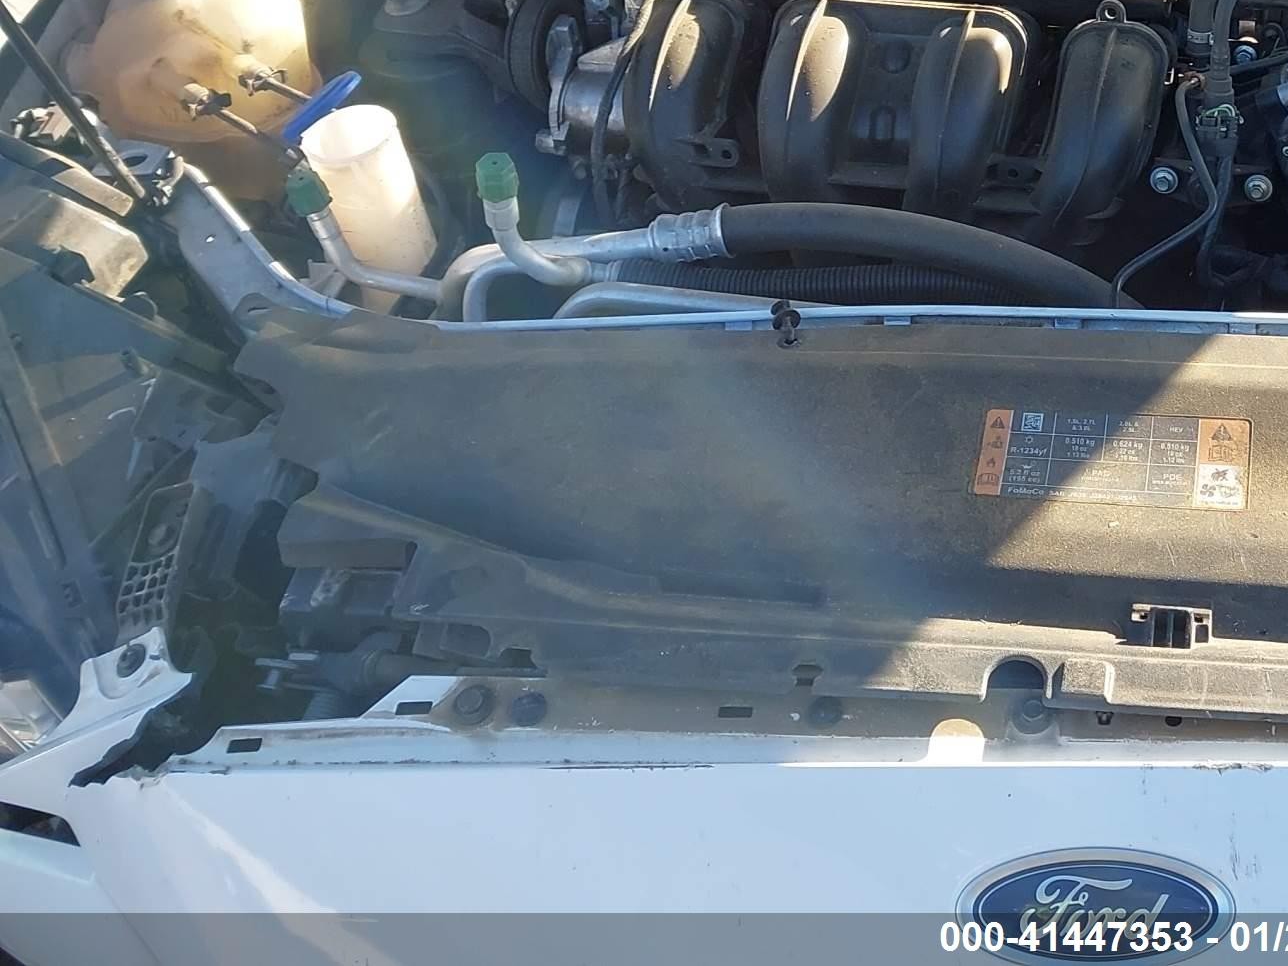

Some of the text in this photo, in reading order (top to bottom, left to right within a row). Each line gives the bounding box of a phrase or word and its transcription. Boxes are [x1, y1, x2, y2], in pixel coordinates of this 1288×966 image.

[1112, 440, 1143, 450] 0.624 kg
[1010, 445, 1047, 457] R-1234yf
[1007, 486, 1045, 496] FoMoCo
[1019, 875, 1169, 941] Ford
